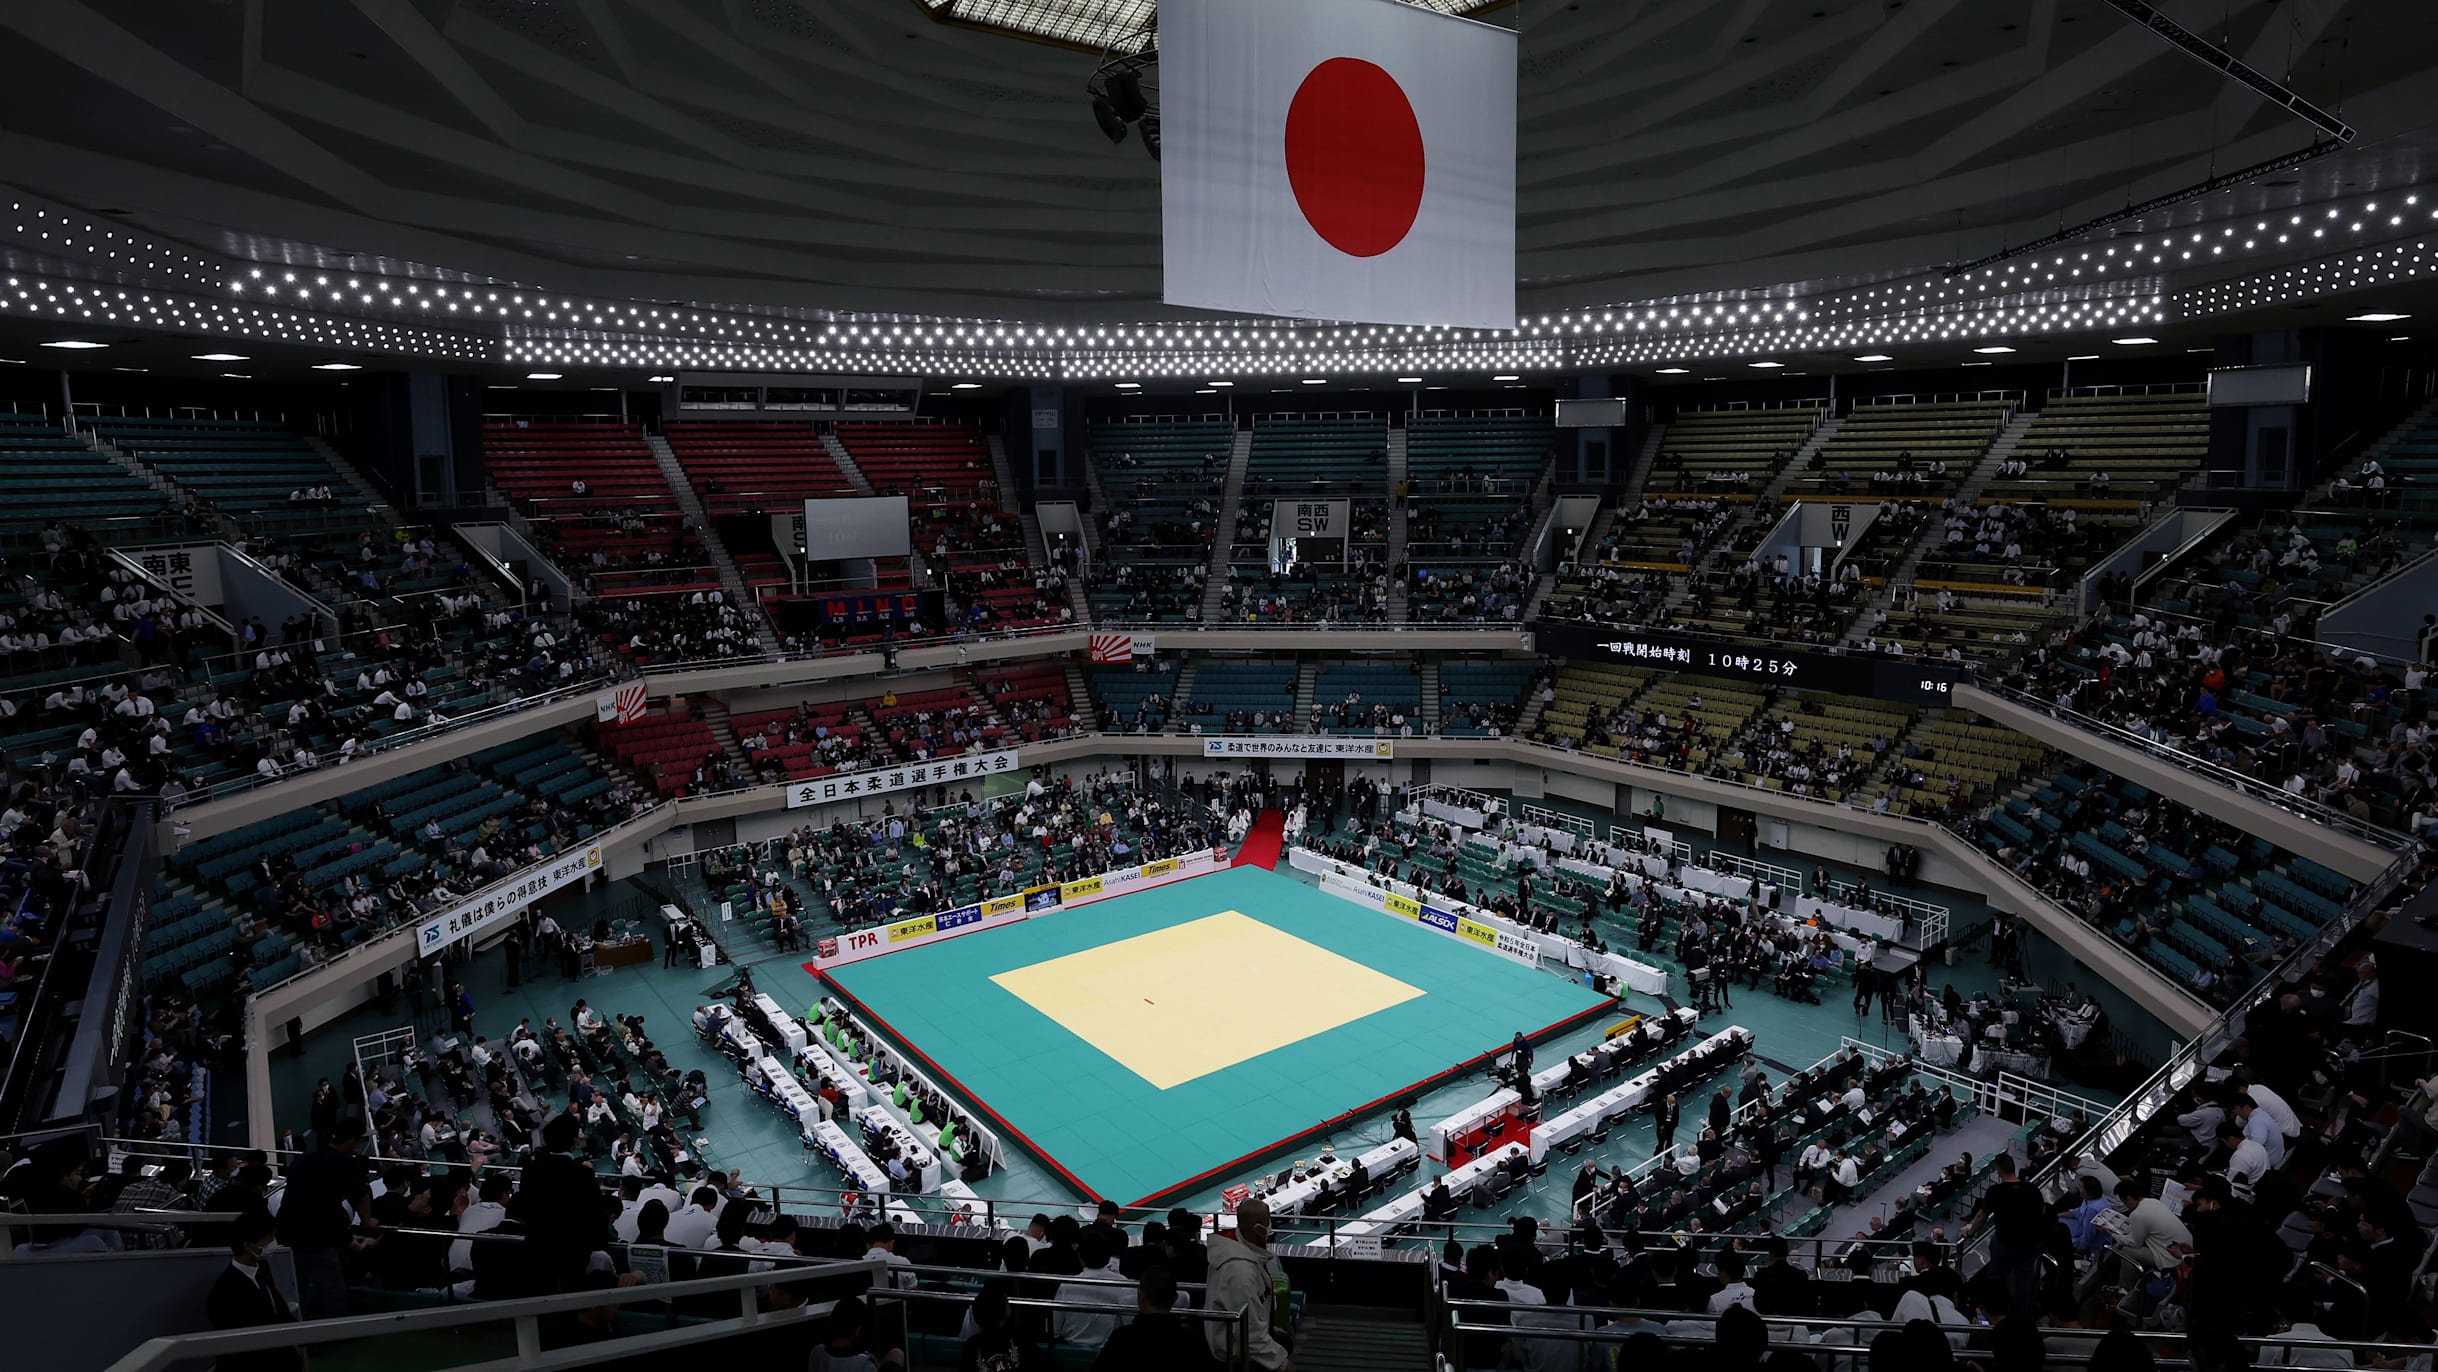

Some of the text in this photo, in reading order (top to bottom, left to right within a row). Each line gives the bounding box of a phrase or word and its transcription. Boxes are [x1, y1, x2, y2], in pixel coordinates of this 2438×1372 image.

[1297, 504, 1329, 517] 南西
[1832, 506, 1851, 522] 西
[1297, 518, 1329, 531] SW
[1832, 523, 1850, 540] W
[1596, 641, 1691, 664] 一回戦開始時刻
[1920, 680, 1948, 693] 10:16
[600, 701, 616, 712] NHK
[1227, 742, 1332, 754] 柔道で世界のみんなと友達に
[1335, 744, 1374, 754] 東洋水産
[799, 756, 1009, 803] 全日本柔道選手権大会
[1148, 862, 1171, 874] Times
[448, 875, 549, 934] 礼儀は僕らの得意技
[552, 856, 587, 882] 東洋水産
[1072, 882, 1101, 895] 東洋水産
[990, 900, 1016, 912] Times
[1393, 899, 1419, 916] 東洋水産
[900, 922, 934, 937] 東洋水産
[1428, 914, 1455, 930] ALSOK
[1466, 924, 1495, 942] 東洋水産
[848, 932, 878, 950] TPR
